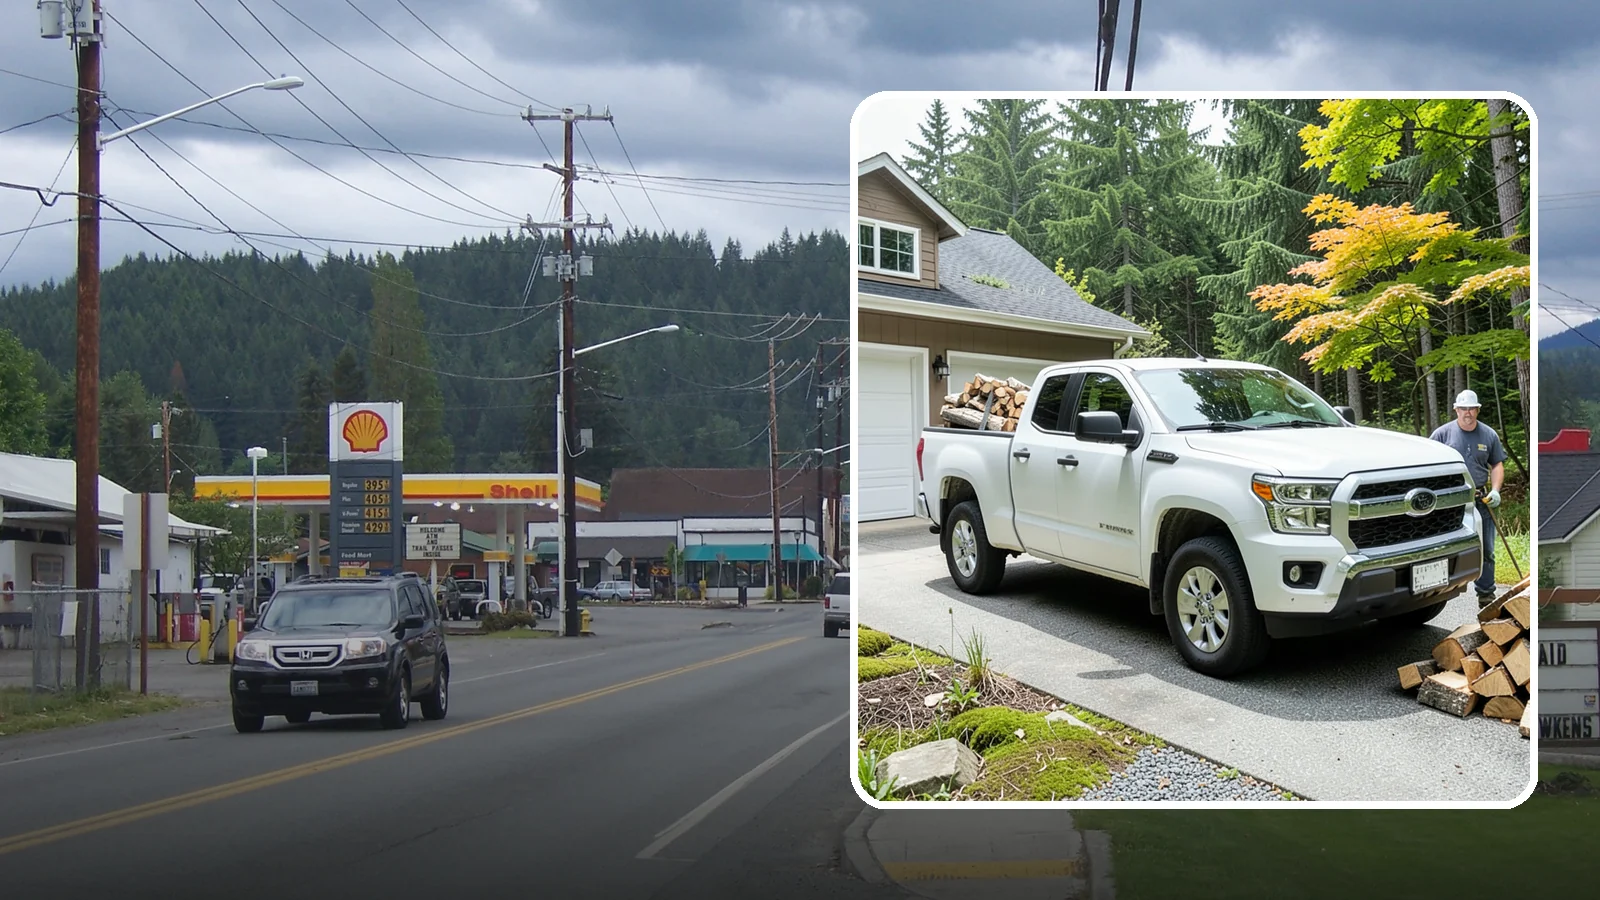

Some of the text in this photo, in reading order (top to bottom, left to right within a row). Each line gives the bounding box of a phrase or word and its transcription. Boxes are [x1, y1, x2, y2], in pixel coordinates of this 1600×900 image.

[366, 480, 383, 490] 395
[490, 484, 547, 499] Shell
[366, 494, 383, 504] 405
[366, 508, 383, 518] 415
[366, 522, 383, 533] 429
[1538, 643, 1567, 665] AID
